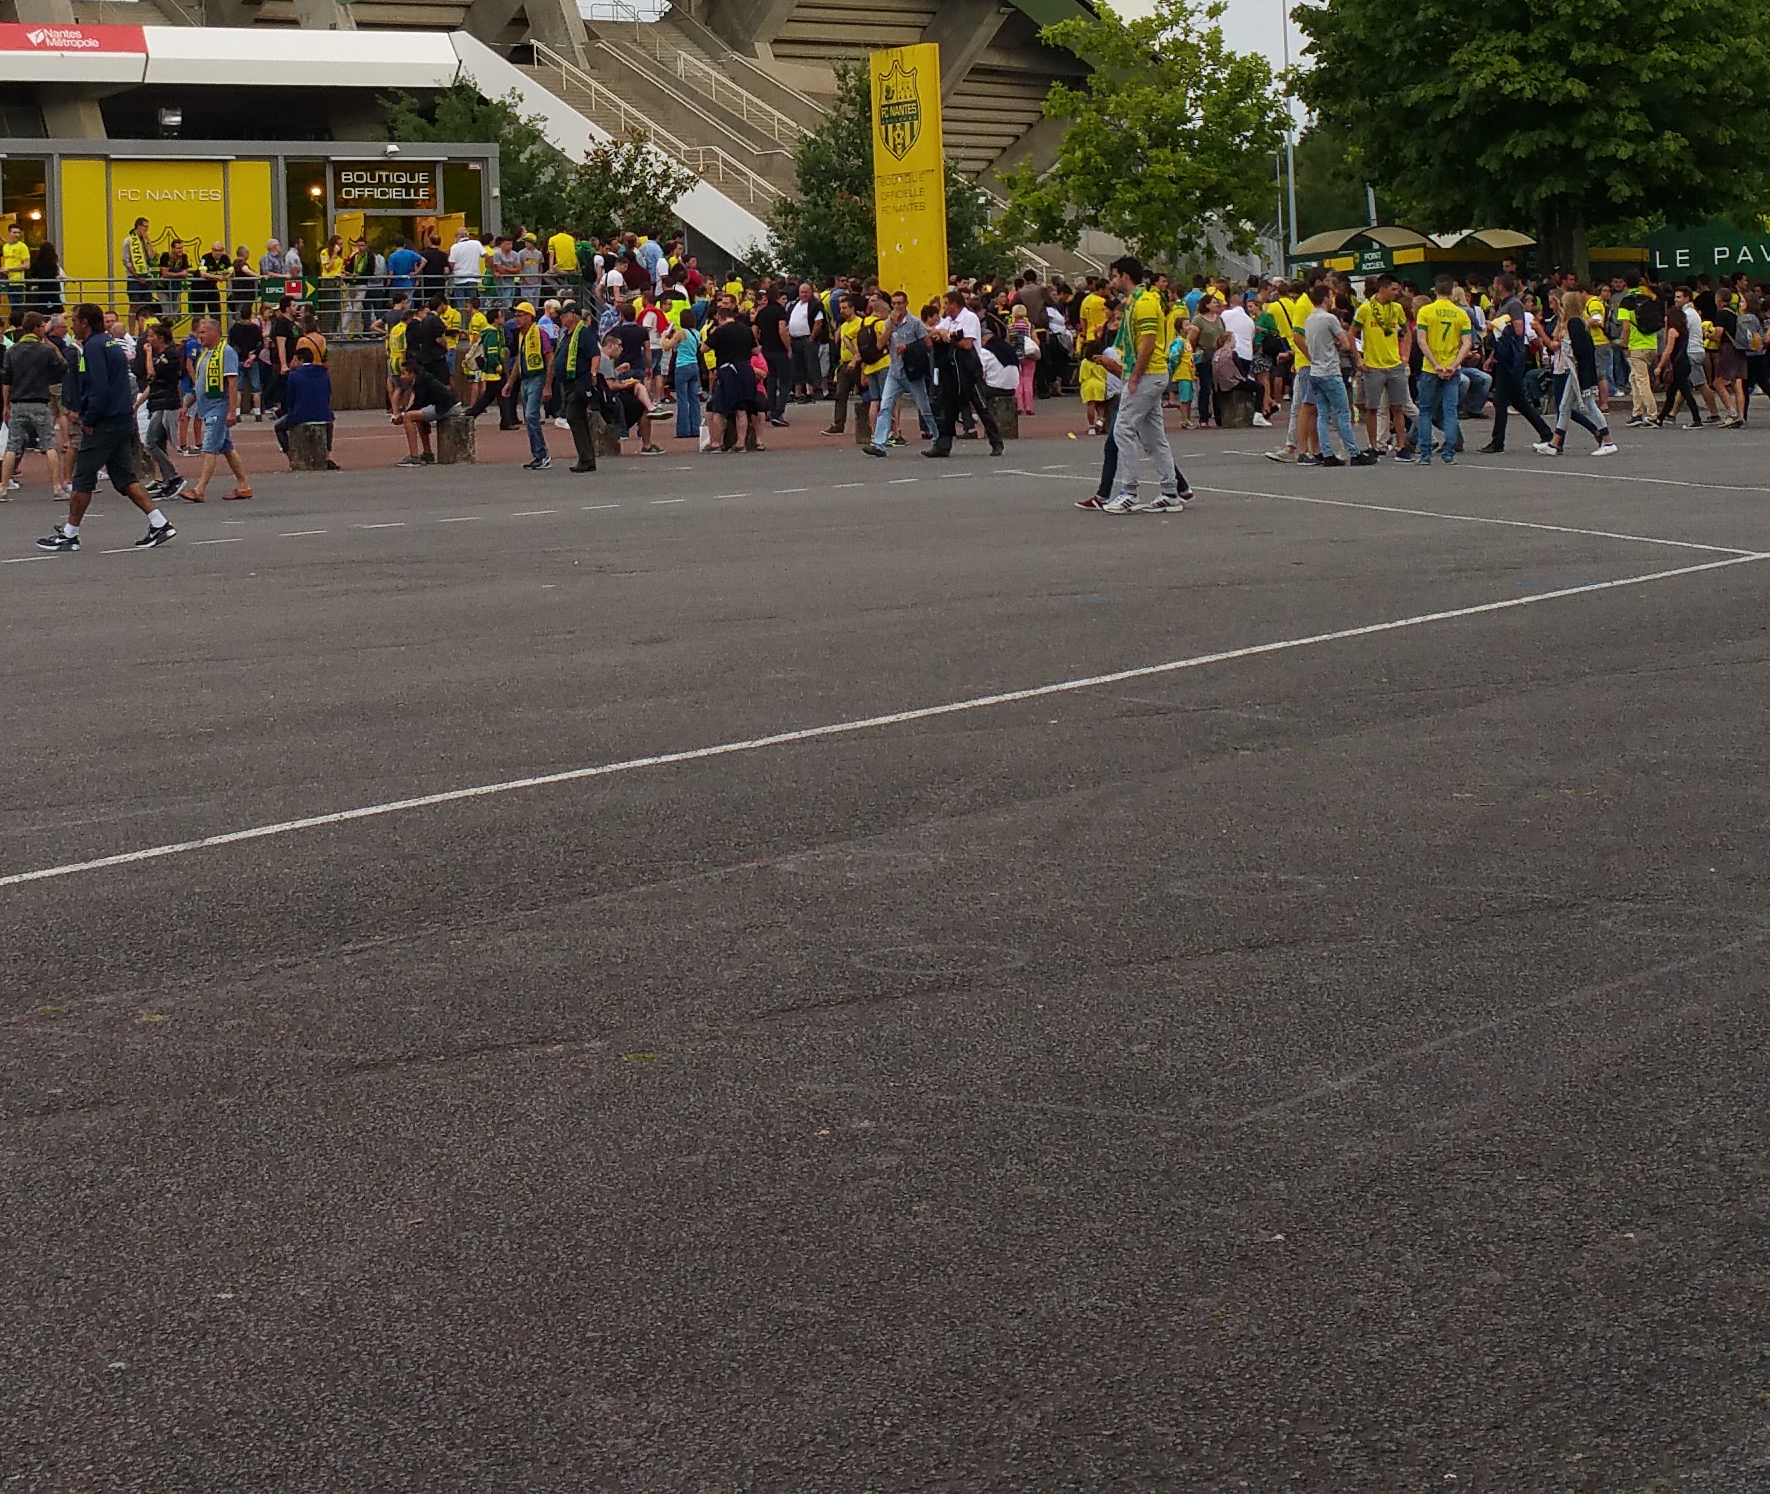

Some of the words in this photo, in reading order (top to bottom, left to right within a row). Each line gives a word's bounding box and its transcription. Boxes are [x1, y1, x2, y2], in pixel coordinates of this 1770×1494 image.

[43, 28, 83, 39] Nantes
[341, 171, 429, 184] BOUTIQUE
[117, 189, 141, 201] FC
[146, 189, 222, 201] NANTES
[342, 187, 430, 199] OFFICIELLE
[1655, 249, 1691, 269] LE
[1440, 321, 1452, 342] 7
